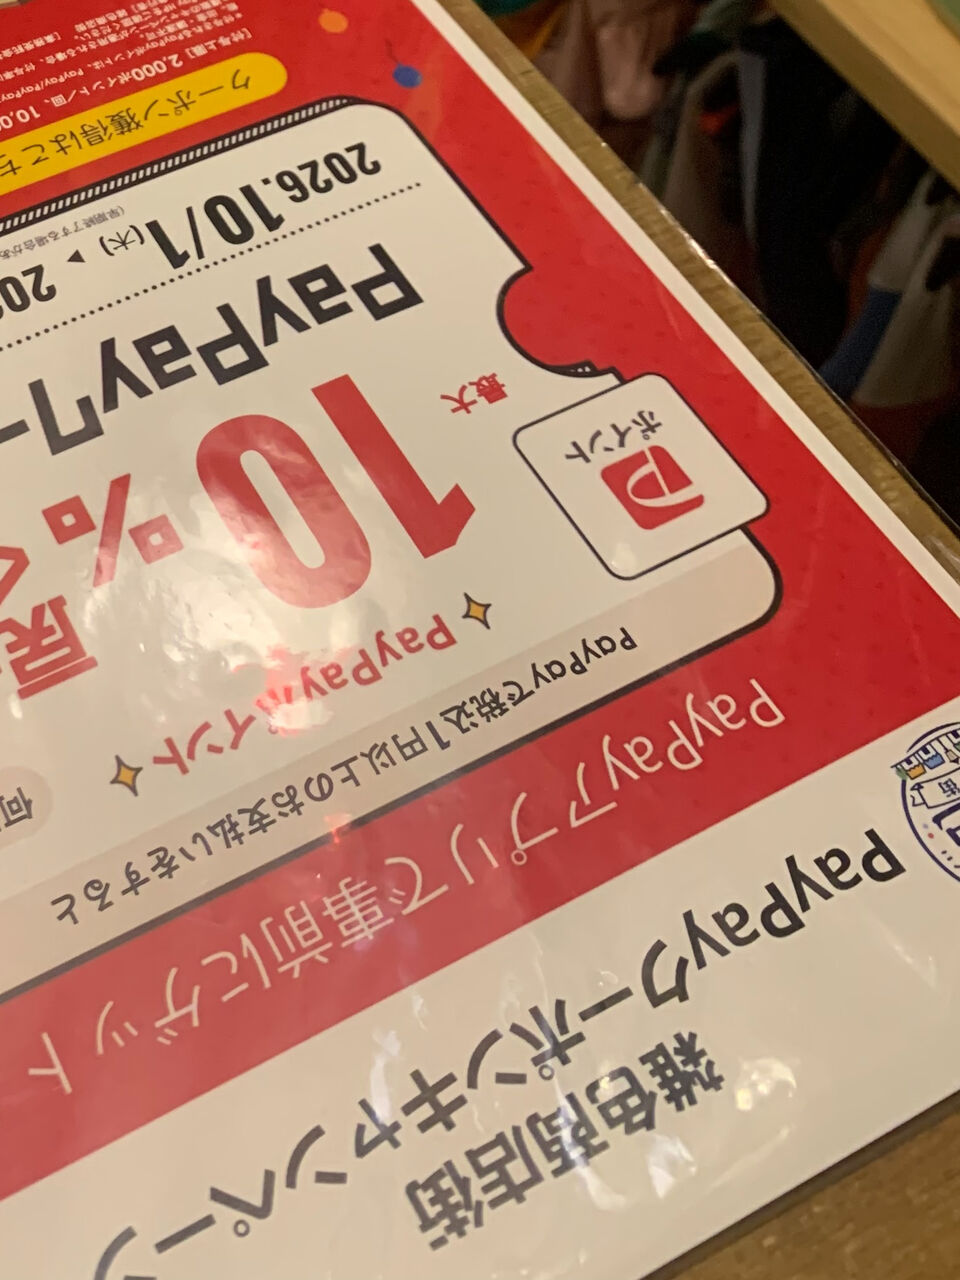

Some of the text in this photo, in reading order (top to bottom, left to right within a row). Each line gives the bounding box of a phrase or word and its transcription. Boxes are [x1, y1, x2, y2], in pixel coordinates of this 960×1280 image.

[97, 141, 383, 271] 2026.10/1(木)
[440, 372, 508, 415] 最大
[563, 409, 663, 465] ポイント
[151, 612, 458, 776] PayPayポイント
[49, 625, 639, 926] PayPayで税込1円以上のお支払いをすると
[404, 1030, 726, 1252] 雑色商店街
